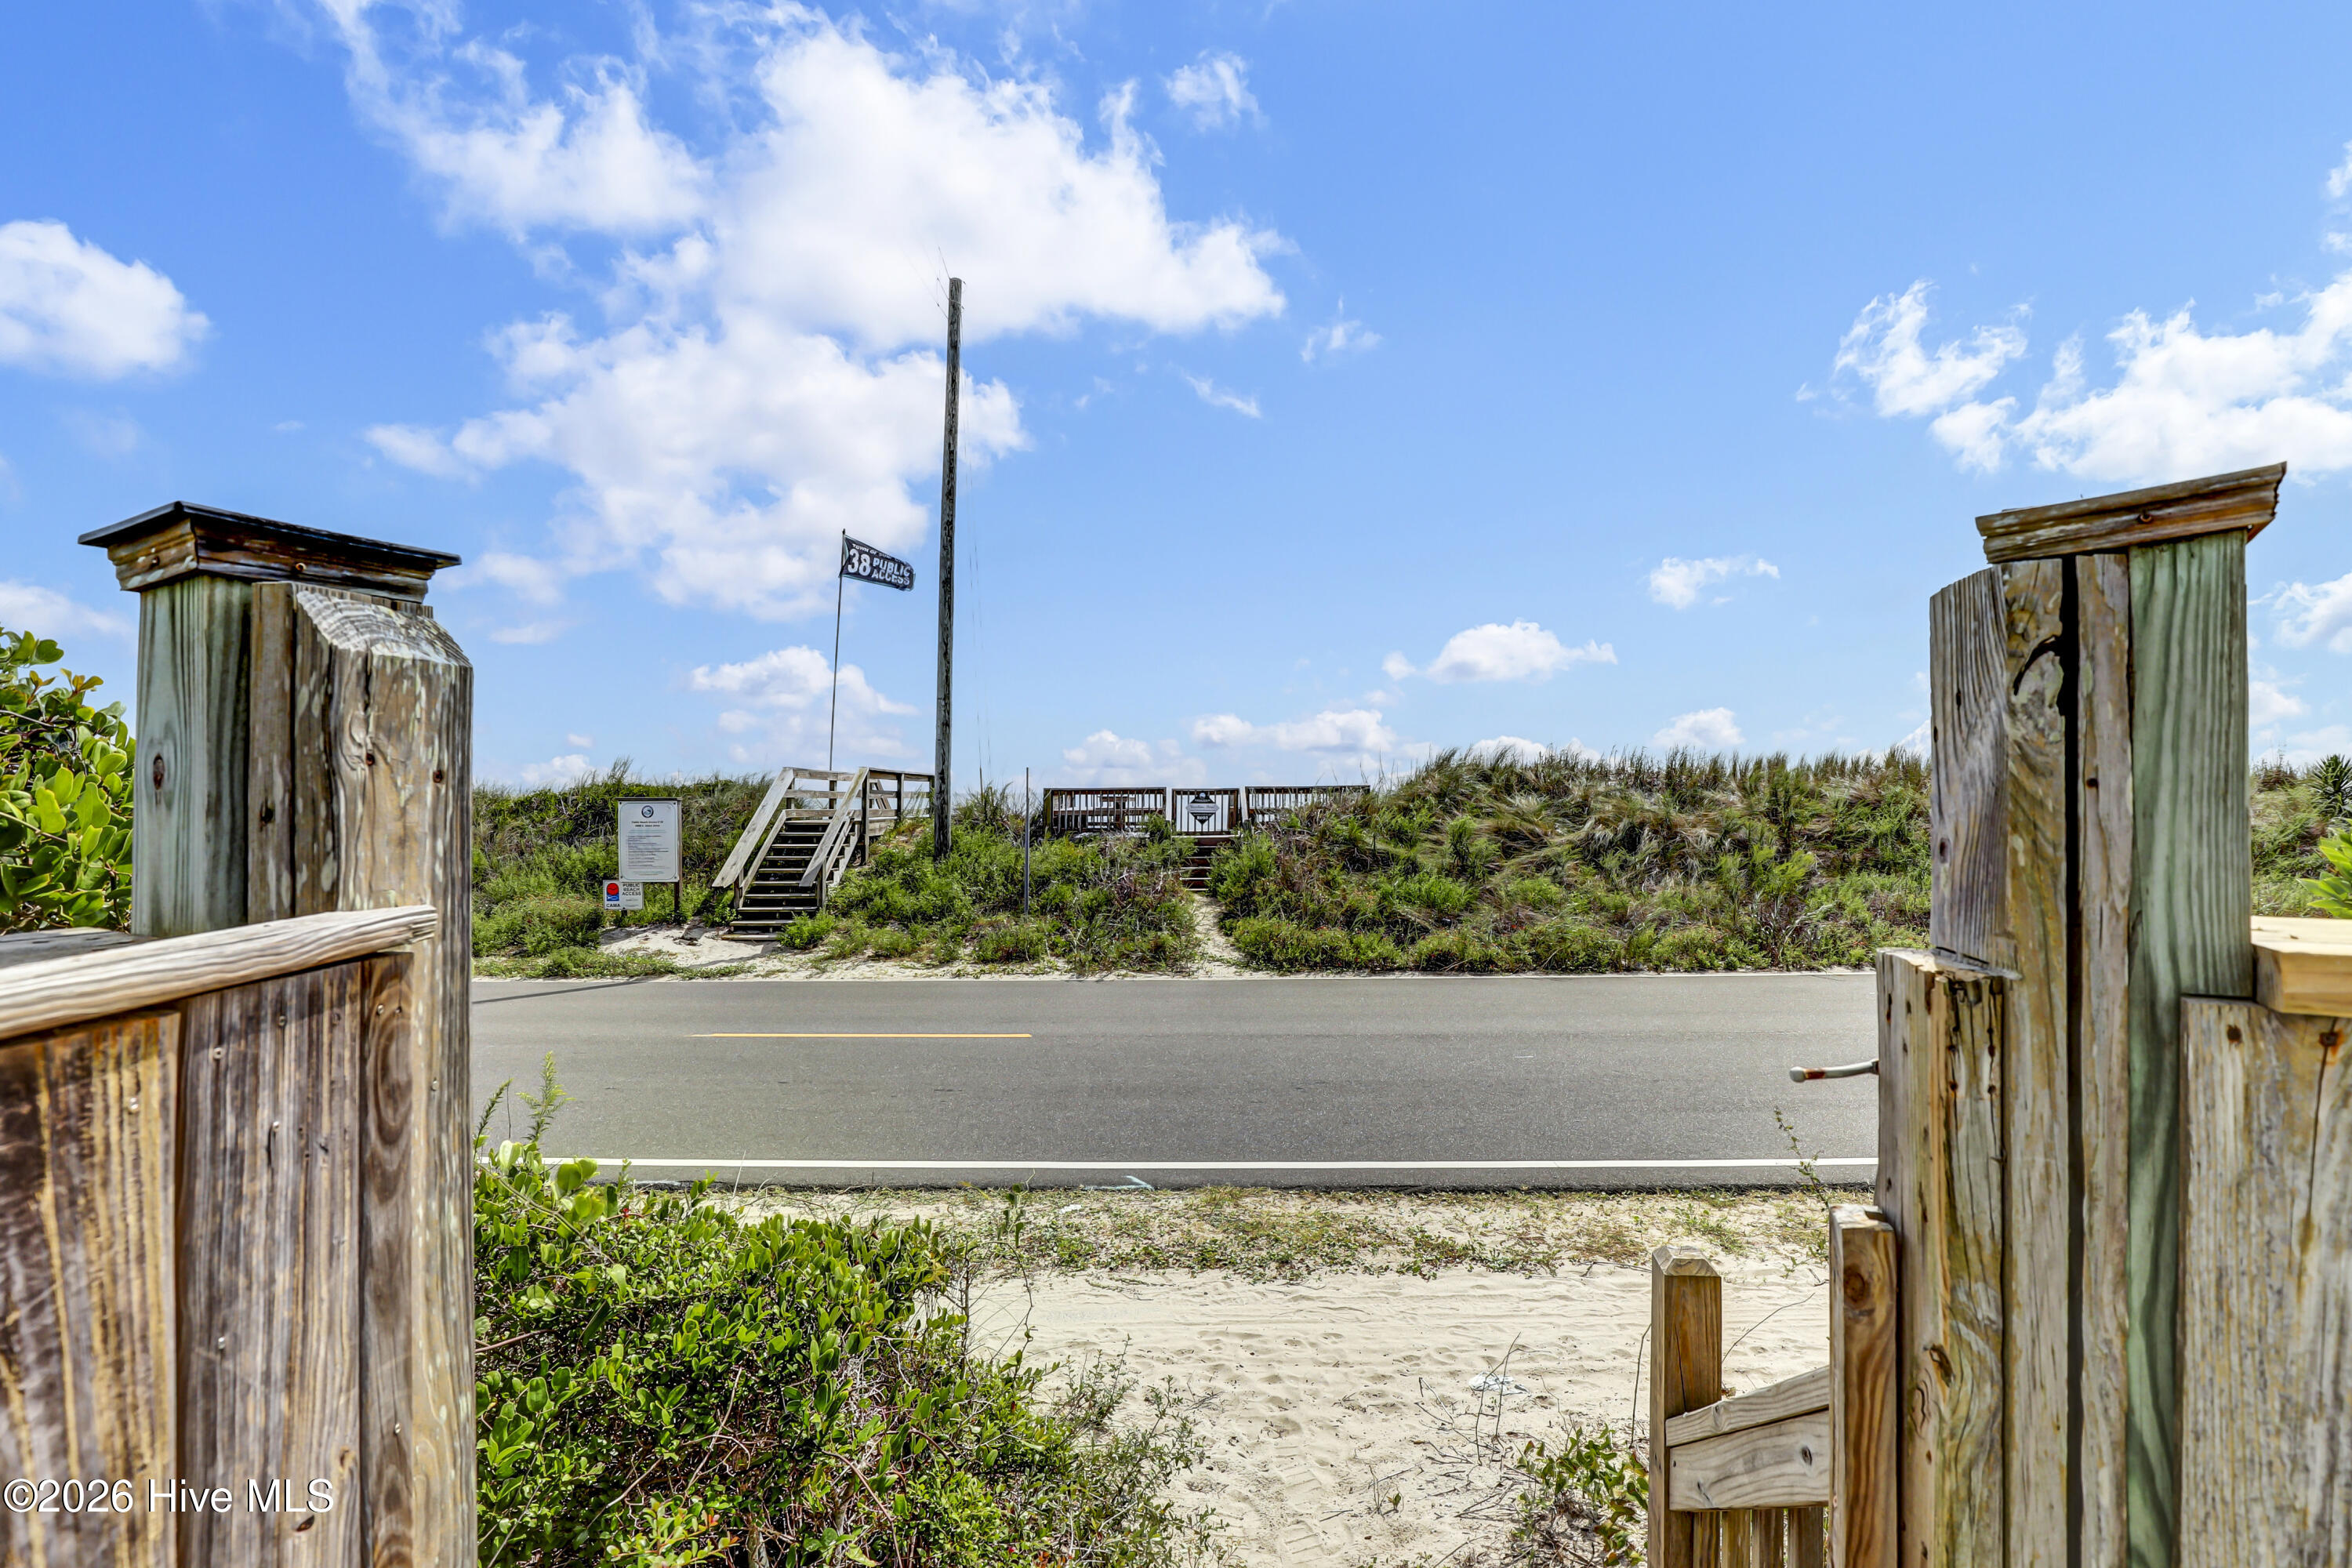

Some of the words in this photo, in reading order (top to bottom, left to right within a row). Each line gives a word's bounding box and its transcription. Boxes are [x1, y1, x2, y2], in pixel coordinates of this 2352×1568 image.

[852, 543, 869, 552] TOWN
[848, 549, 871, 575] 38
[873, 557, 910, 576] PUBLIC
[872, 569, 910, 585] ACCESS
